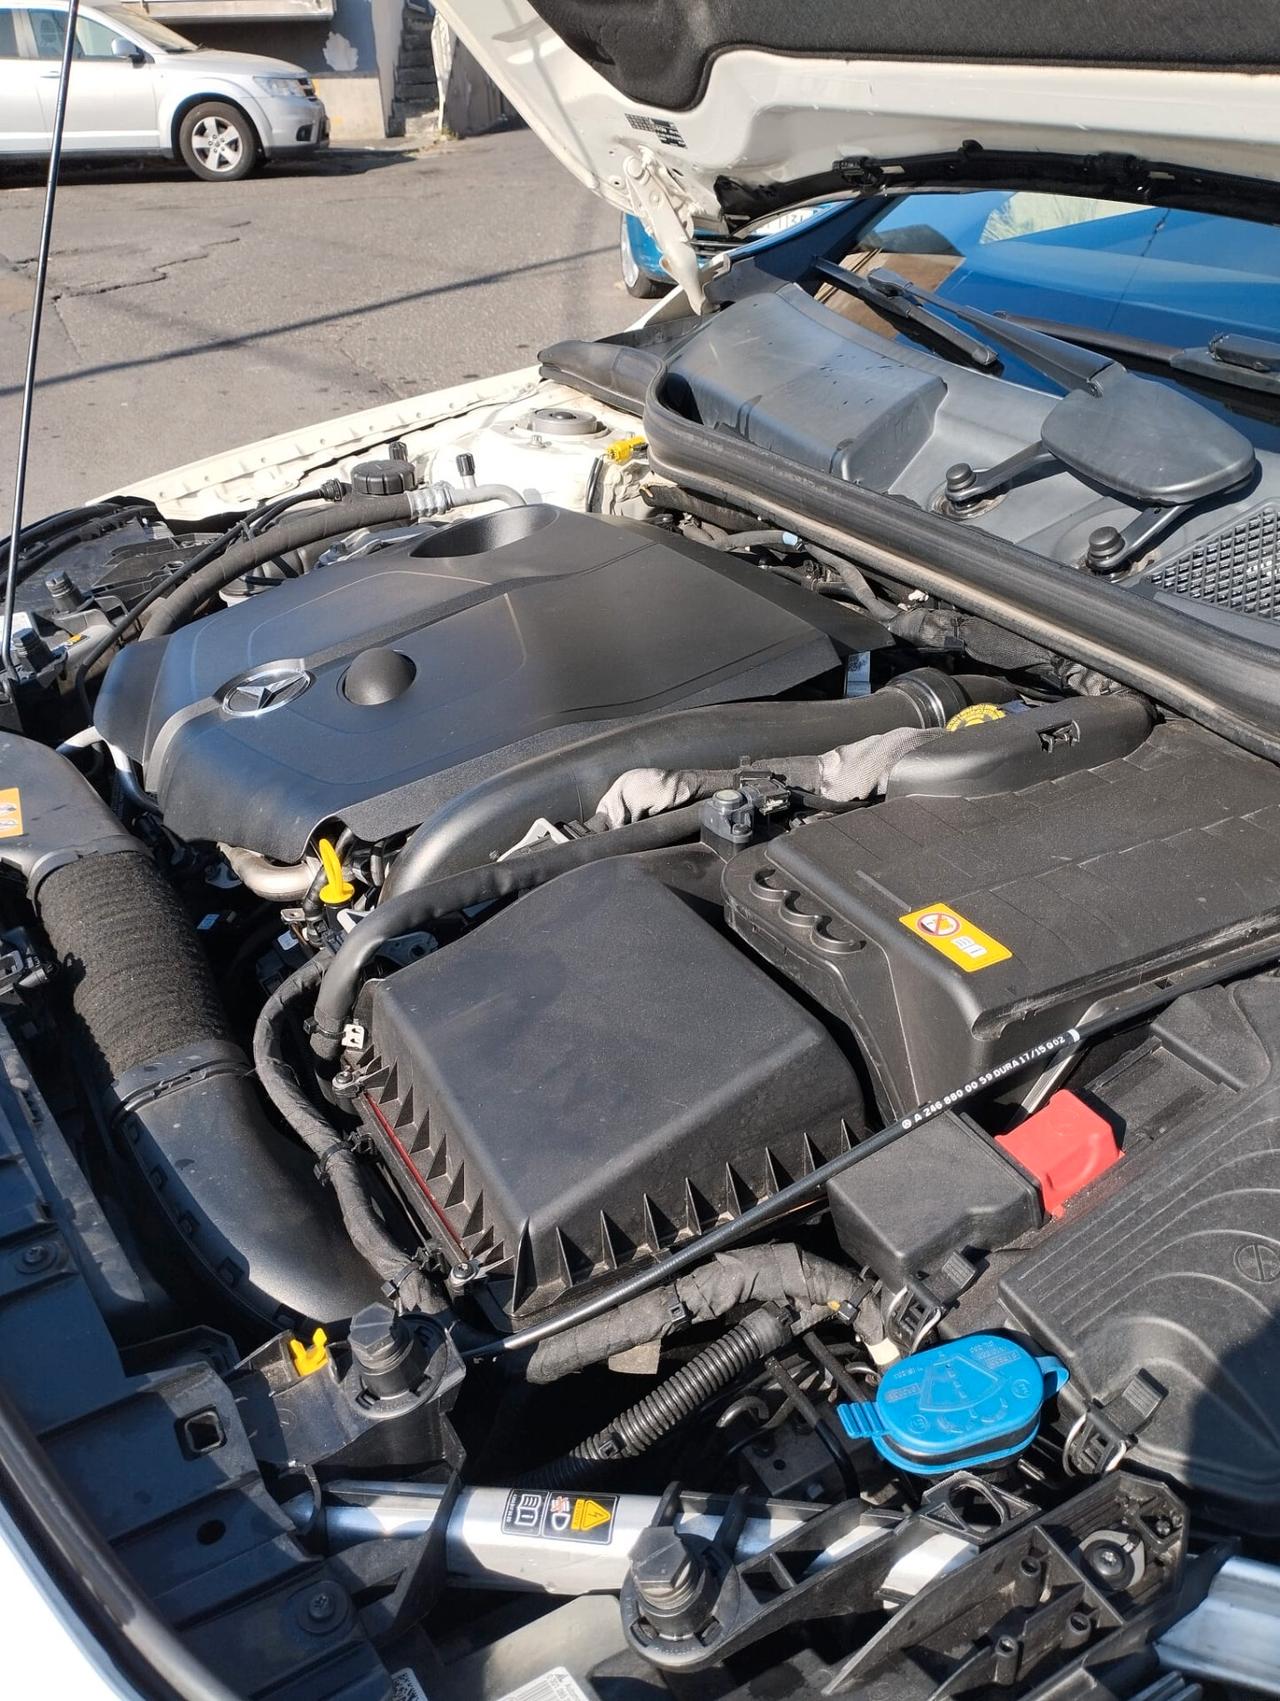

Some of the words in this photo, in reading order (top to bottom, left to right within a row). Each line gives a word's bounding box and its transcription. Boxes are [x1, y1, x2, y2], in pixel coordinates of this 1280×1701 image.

[913, 1113, 923, 1123] A
[924, 1101, 942, 1117] 246
[943, 1090, 964, 1105] 880
[965, 1081, 978, 1093] 00
[979, 1073, 993, 1085] 59
[993, 1059, 1020, 1078] DURA
